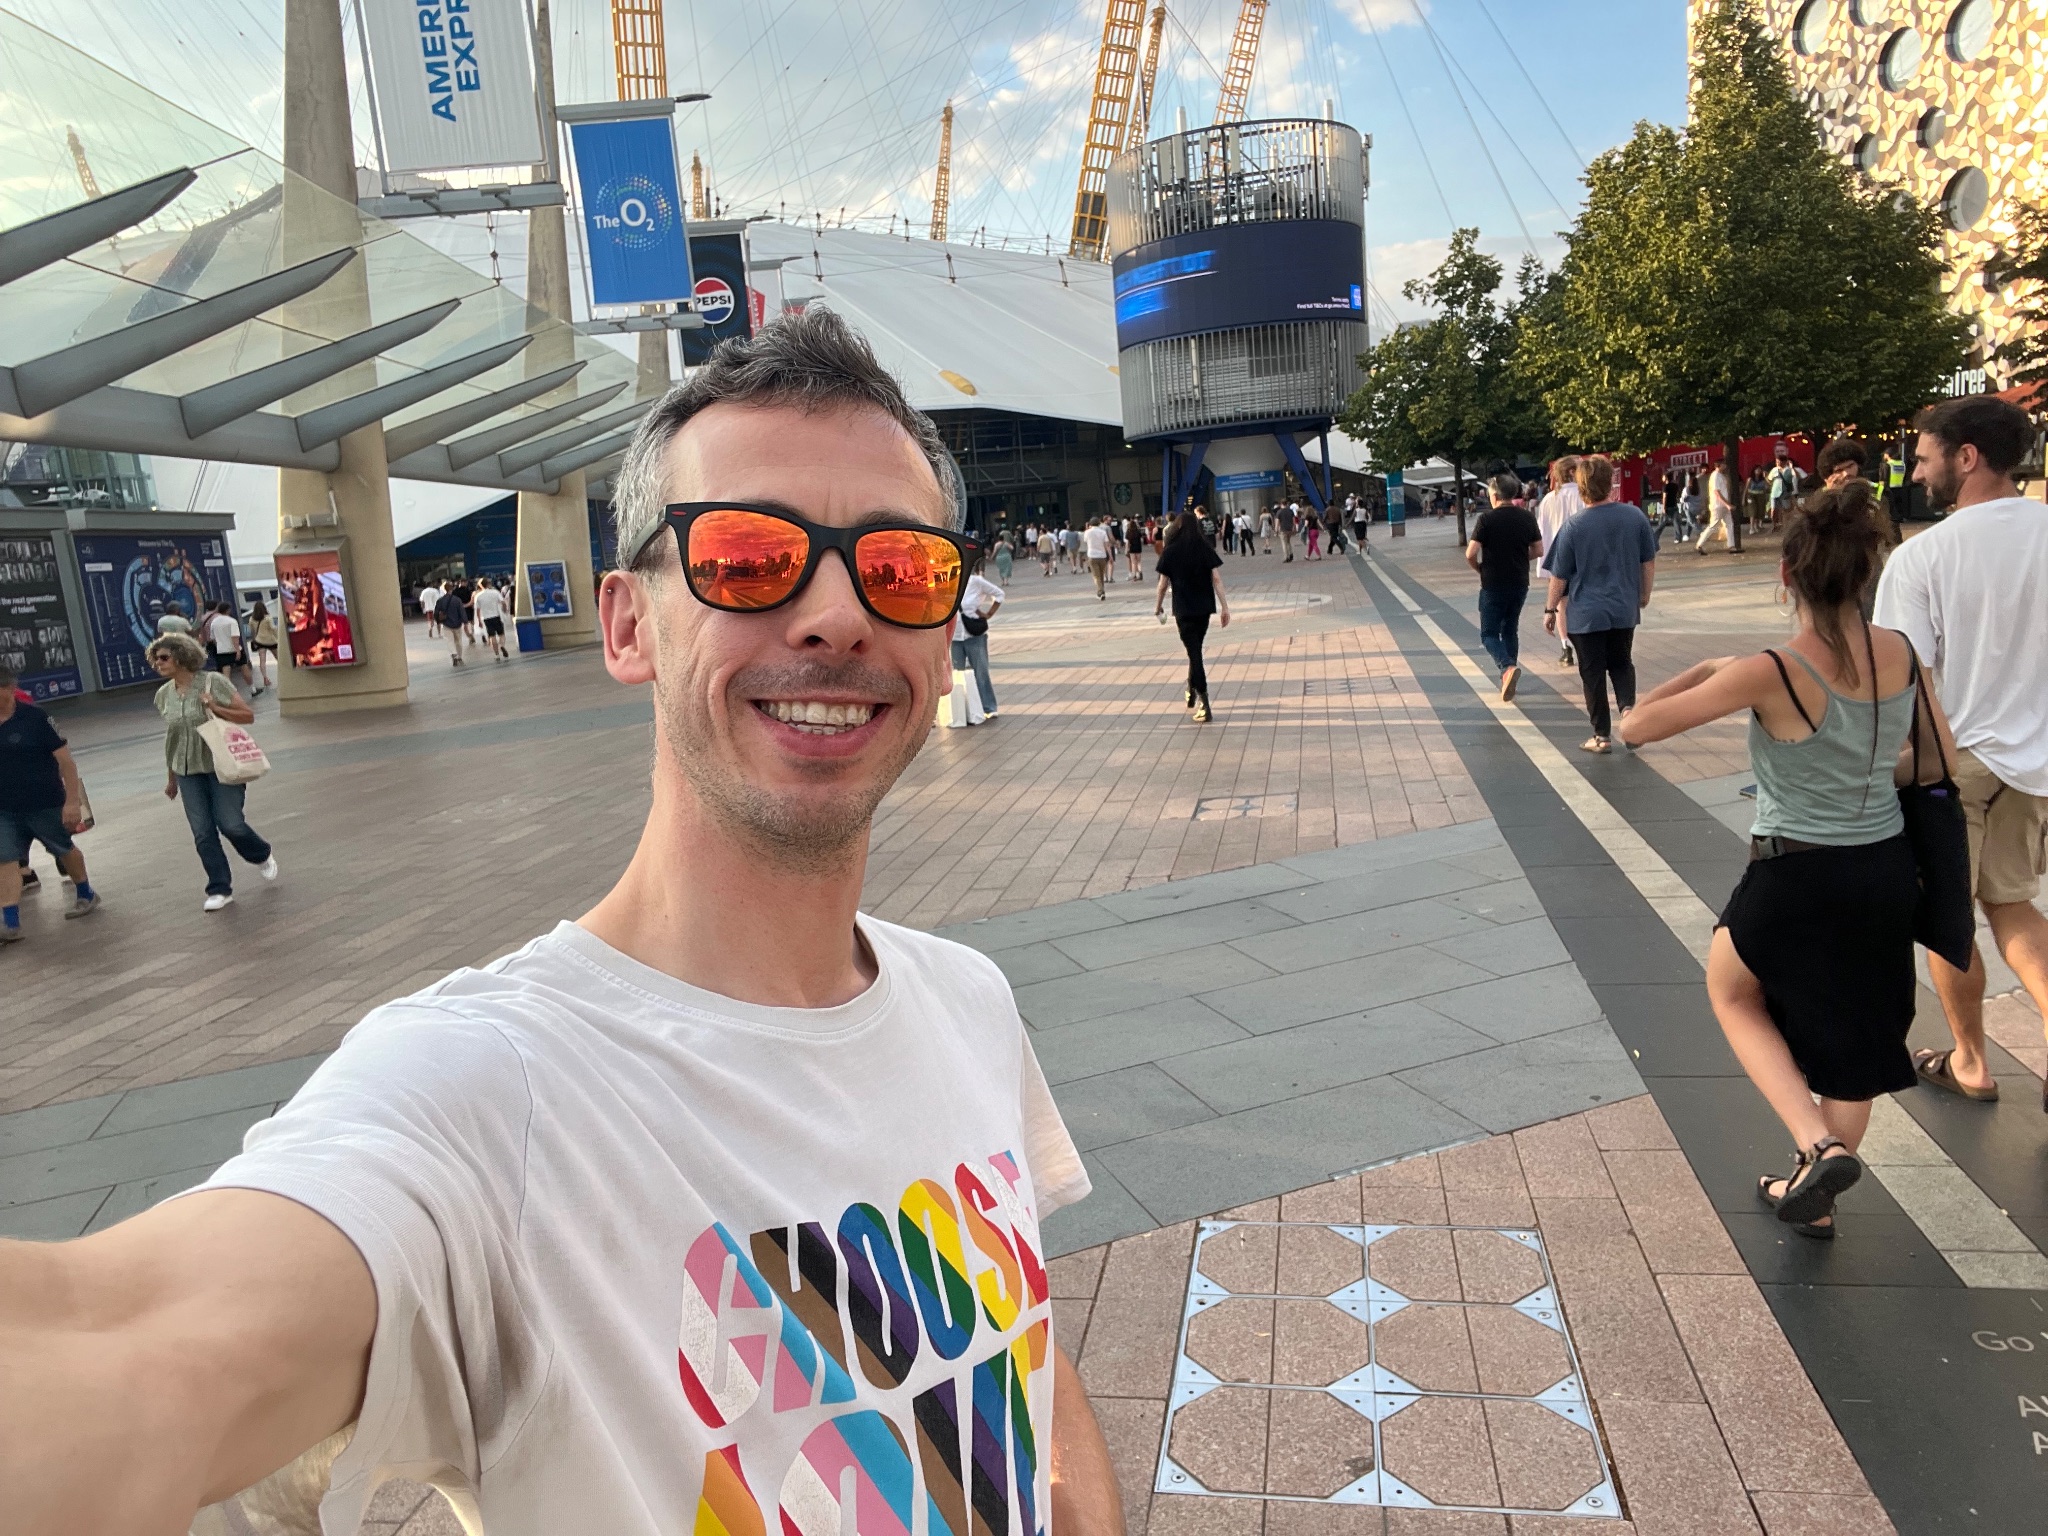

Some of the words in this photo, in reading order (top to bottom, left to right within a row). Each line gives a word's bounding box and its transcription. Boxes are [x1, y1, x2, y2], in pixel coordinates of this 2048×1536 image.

[416, 0, 456, 122] AMERI
[592, 214, 620, 229] The
[620, 198, 655, 232] O2
